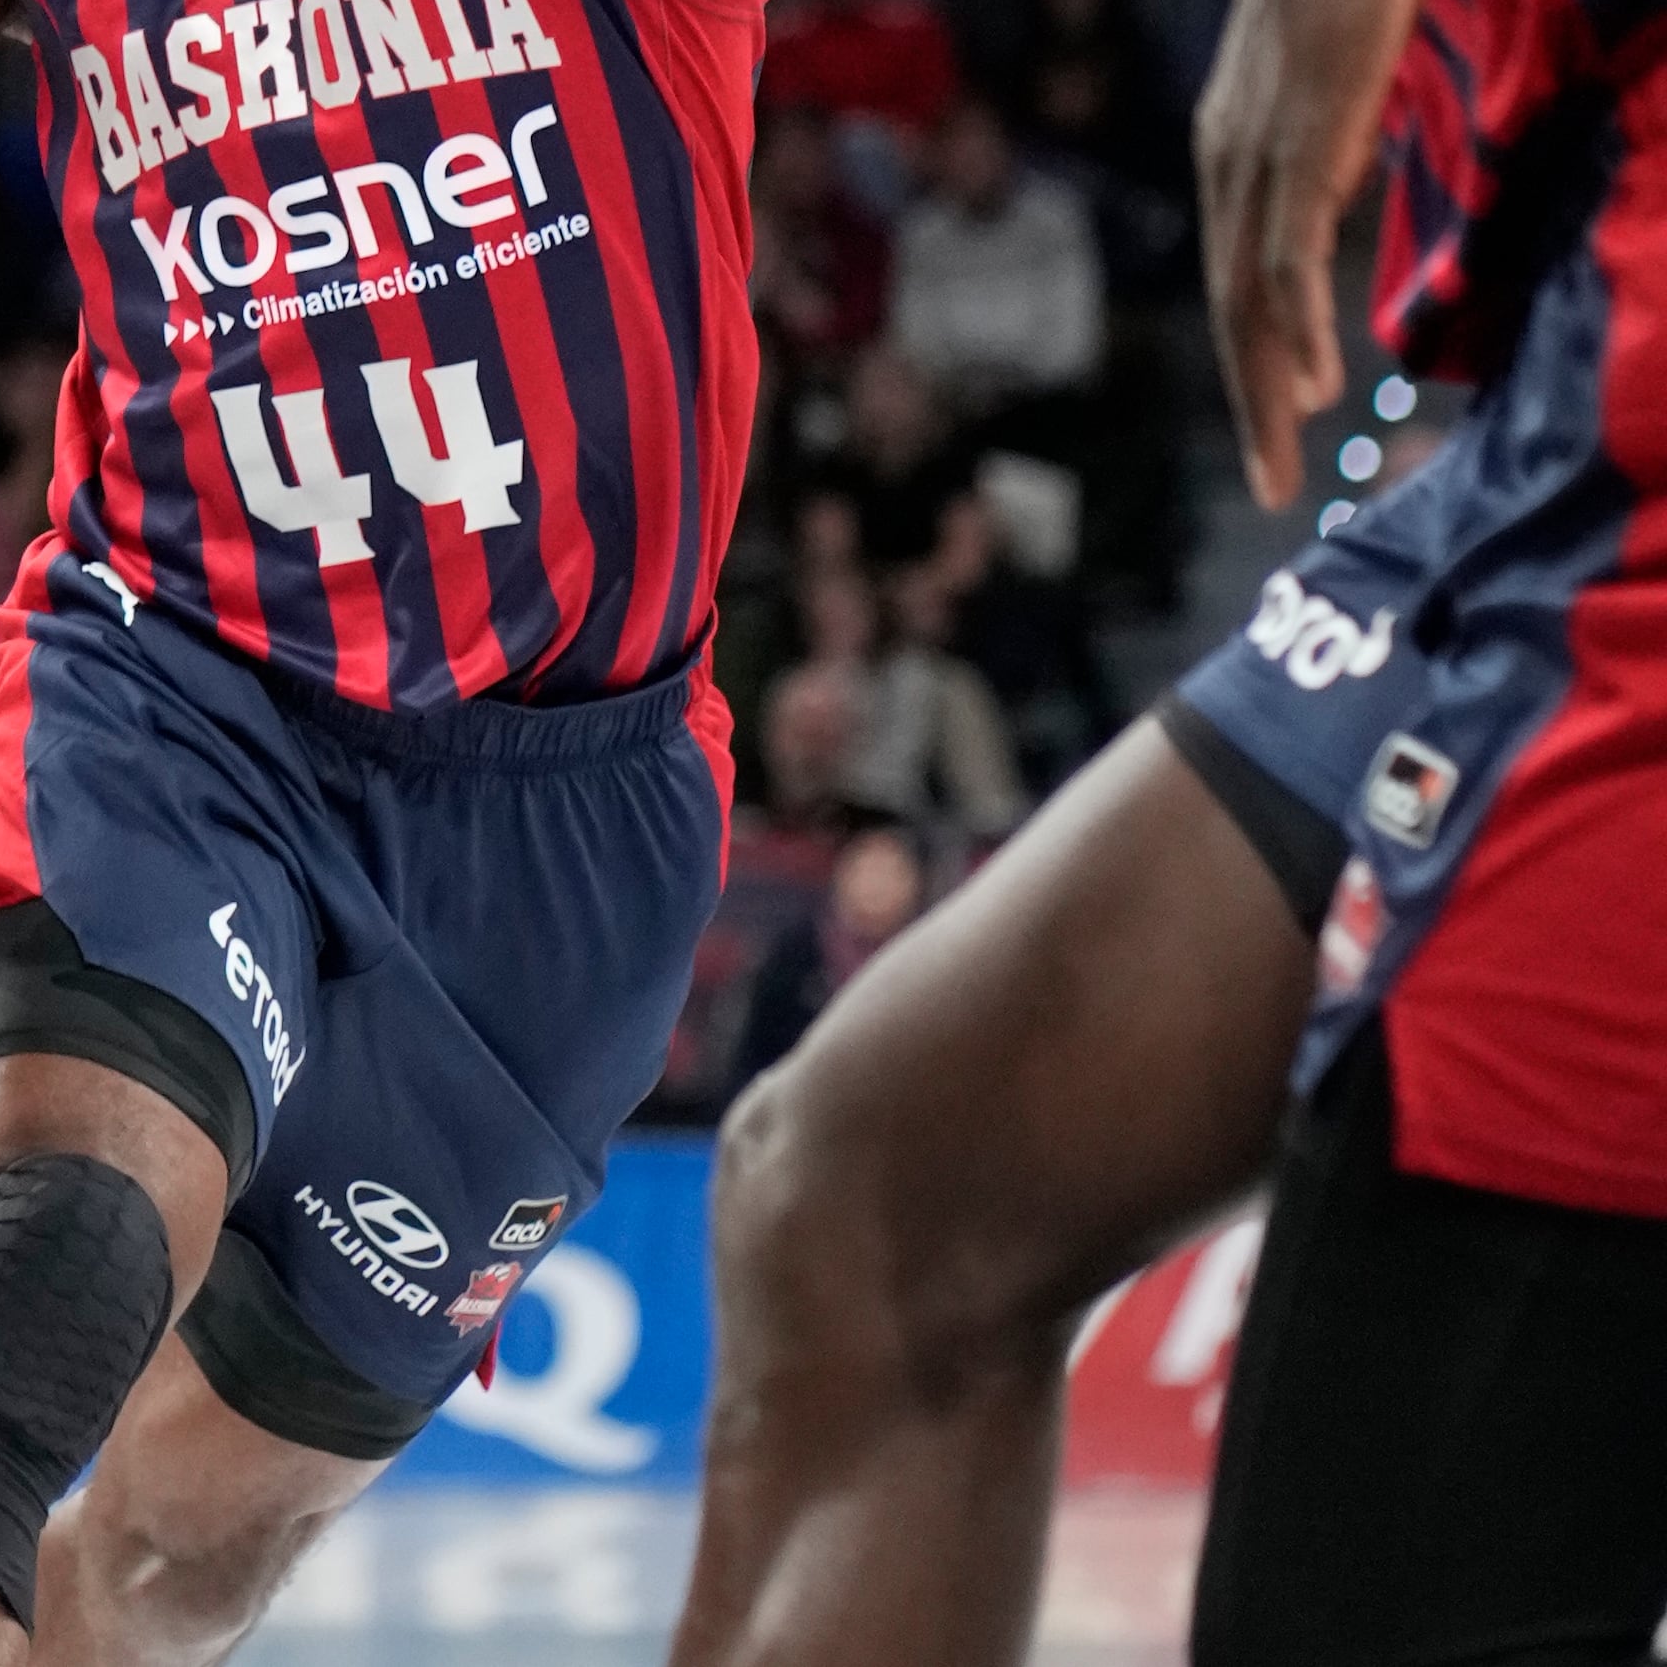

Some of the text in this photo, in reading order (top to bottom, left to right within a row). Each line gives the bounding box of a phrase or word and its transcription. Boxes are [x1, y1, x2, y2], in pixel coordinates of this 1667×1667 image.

[242, 210, 591, 330] Climatización eficiente
[209, 356, 525, 568] 44
[294, 1184, 439, 1317] HYUNDAI
[502, 1219, 547, 1243] acb
